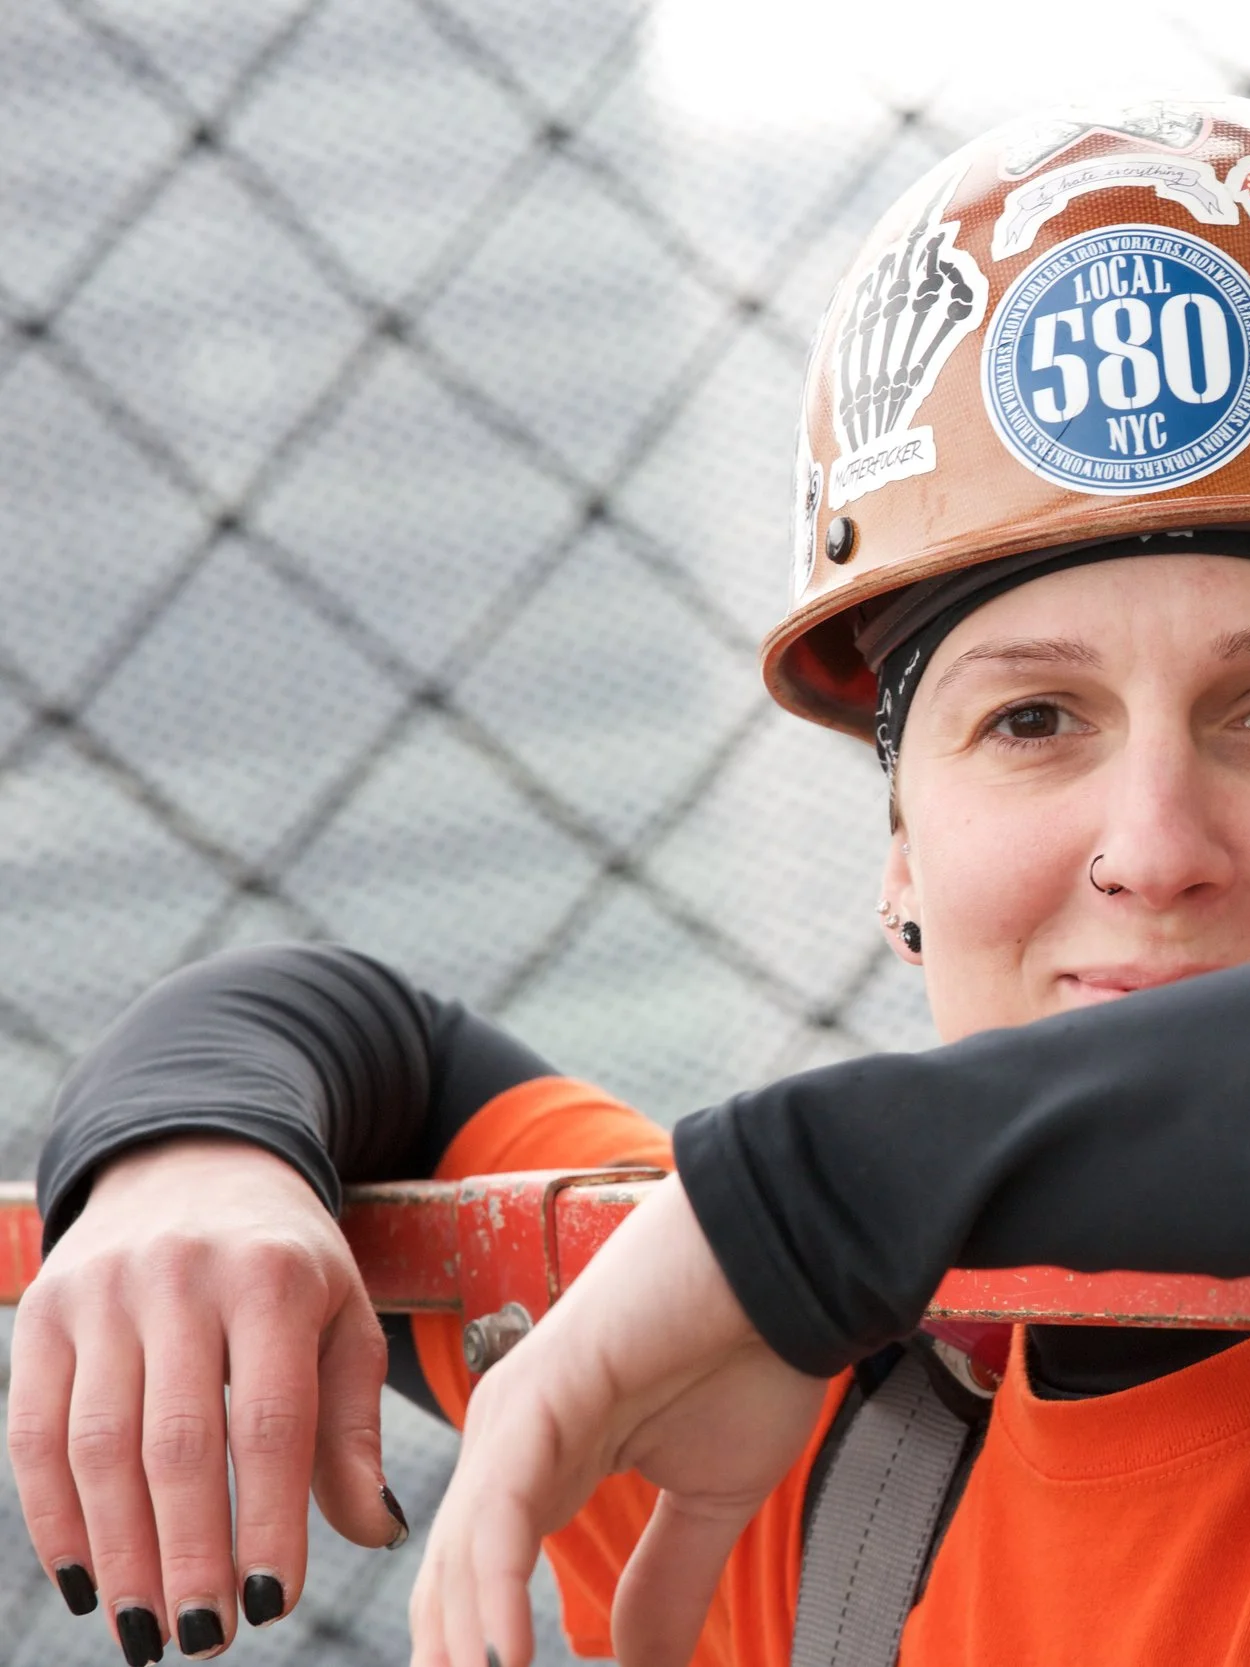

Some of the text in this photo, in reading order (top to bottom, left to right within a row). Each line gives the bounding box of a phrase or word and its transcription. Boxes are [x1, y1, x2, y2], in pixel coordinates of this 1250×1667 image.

[1057, 170, 1097, 191] hate
[1104, 165, 1186, 181] everything
[1073, 255, 1171, 304] LOCAL
[1031, 294, 1232, 424] 580
[1106, 412, 1168, 456] NYC
[834, 439, 925, 489] MOTHERFUCKER
